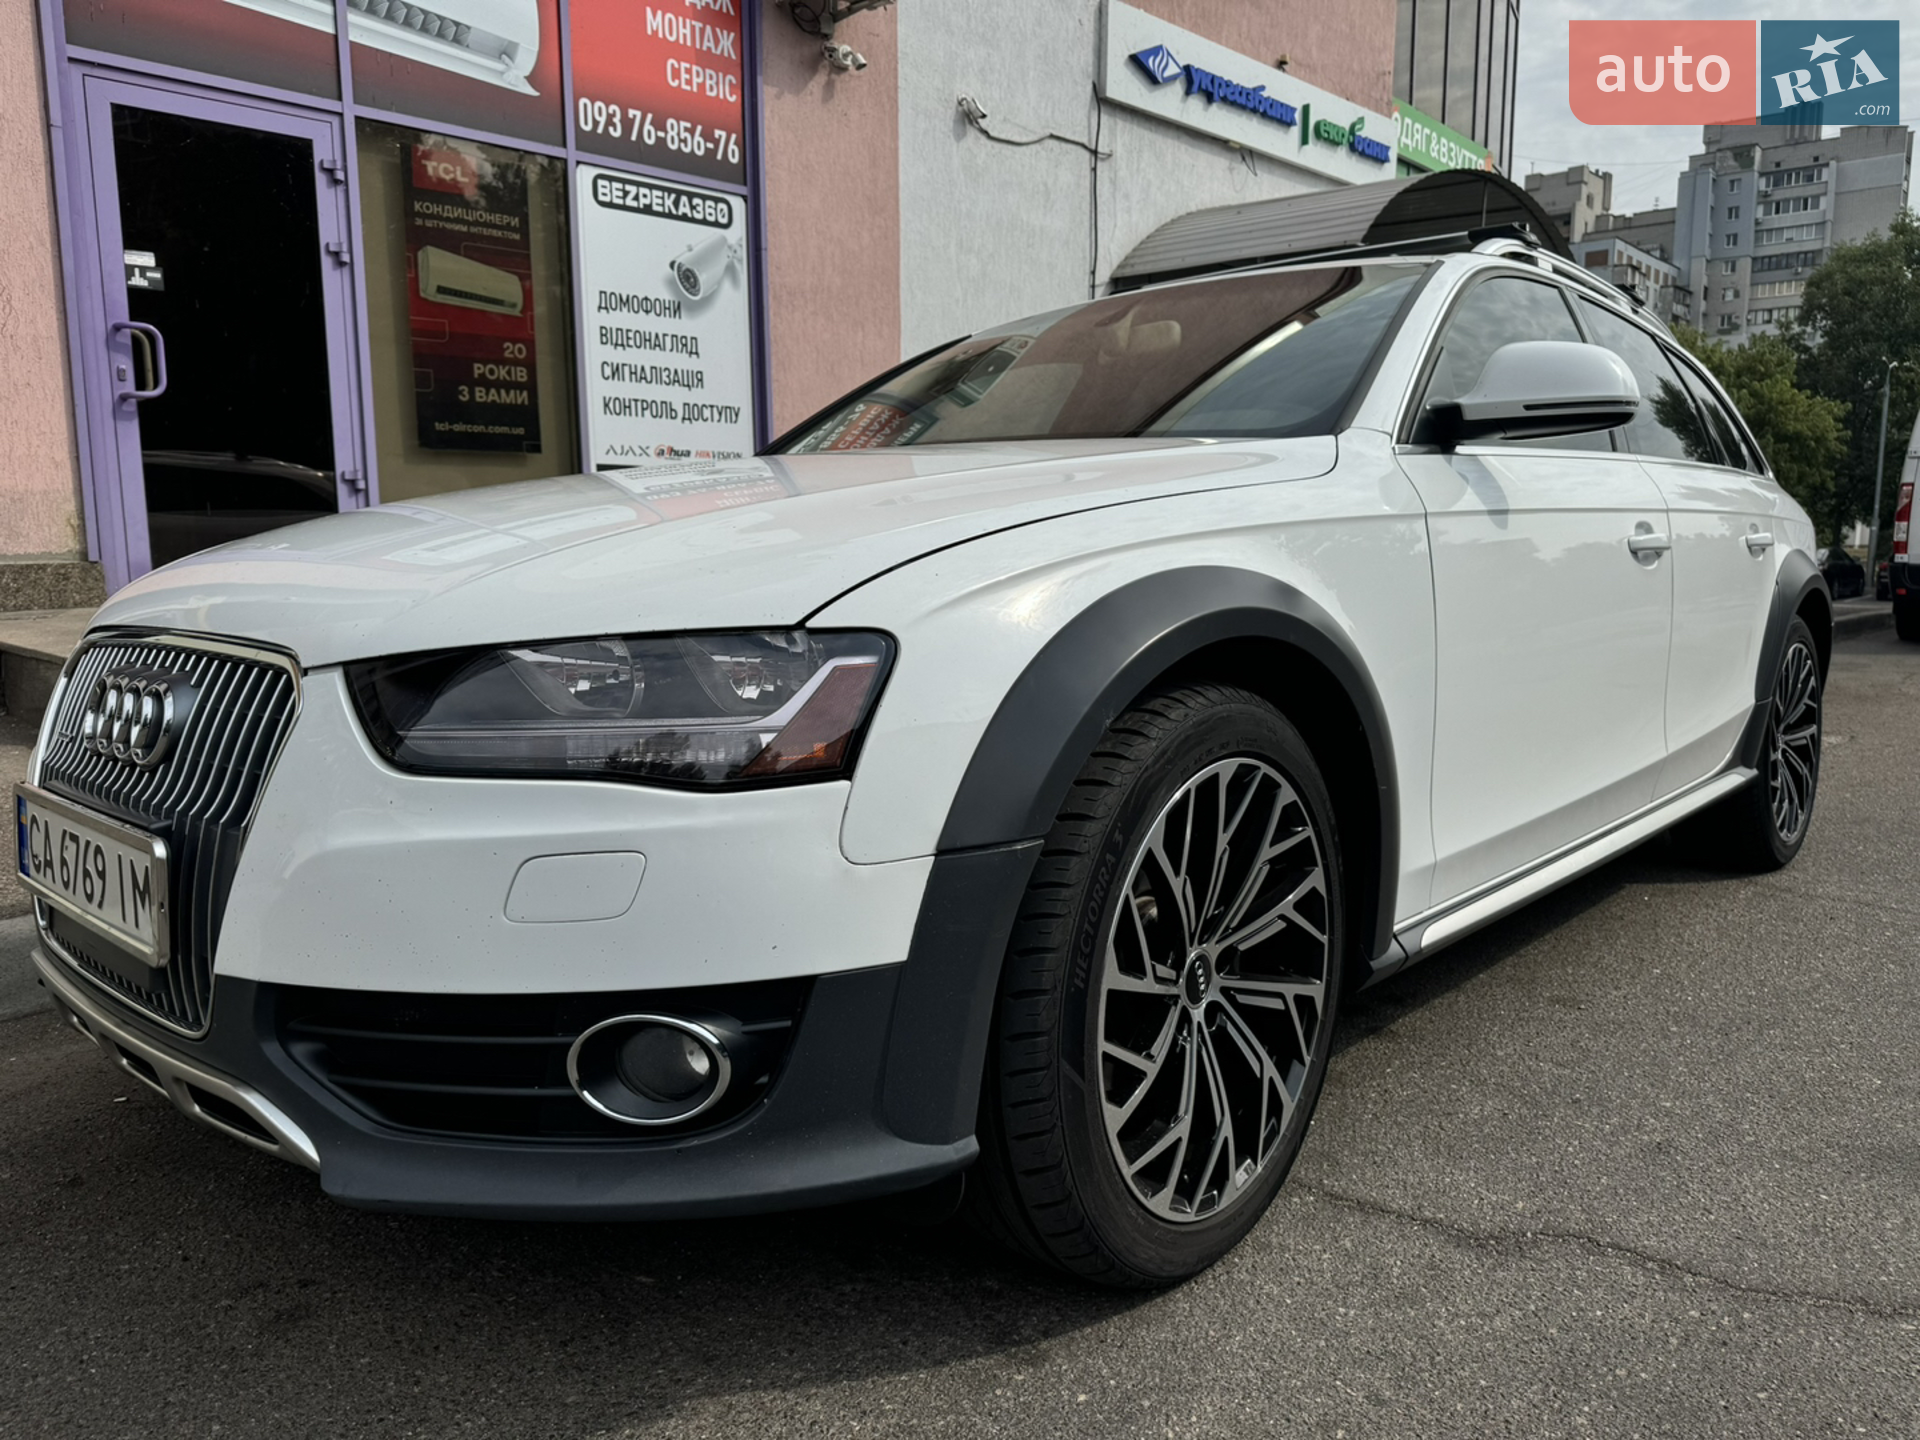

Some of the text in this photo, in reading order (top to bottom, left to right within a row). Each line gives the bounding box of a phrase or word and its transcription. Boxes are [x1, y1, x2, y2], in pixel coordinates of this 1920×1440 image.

[645, 6, 736, 60] МОНТАЖ
[666, 58, 737, 102] СЕРВІС
[578, 97, 739, 164] 093 76-856-76
[421, 160, 469, 182] TCL
[414, 200, 520, 228] КОНДИЦІОНЕРИ
[597, 179, 729, 225] BEZPEKA360
[597, 290, 683, 320] ДОМОФОНИ
[503, 342, 528, 359] 20
[600, 325, 701, 359] ВІДЕОНАГЛЯД
[473, 363, 529, 382] РОКІВ
[601, 361, 705, 391] СИГНАЛІЗАЦІЯ
[474, 387, 529, 406] ВАМИ
[603, 396, 741, 425] КОНТРОЛЬ ДОСТУПУ
[434, 422, 525, 435] tcl-aircon.com.ua
[605, 444, 650, 457] AJAX
[29, 812, 151, 930] CA 6769 IM
